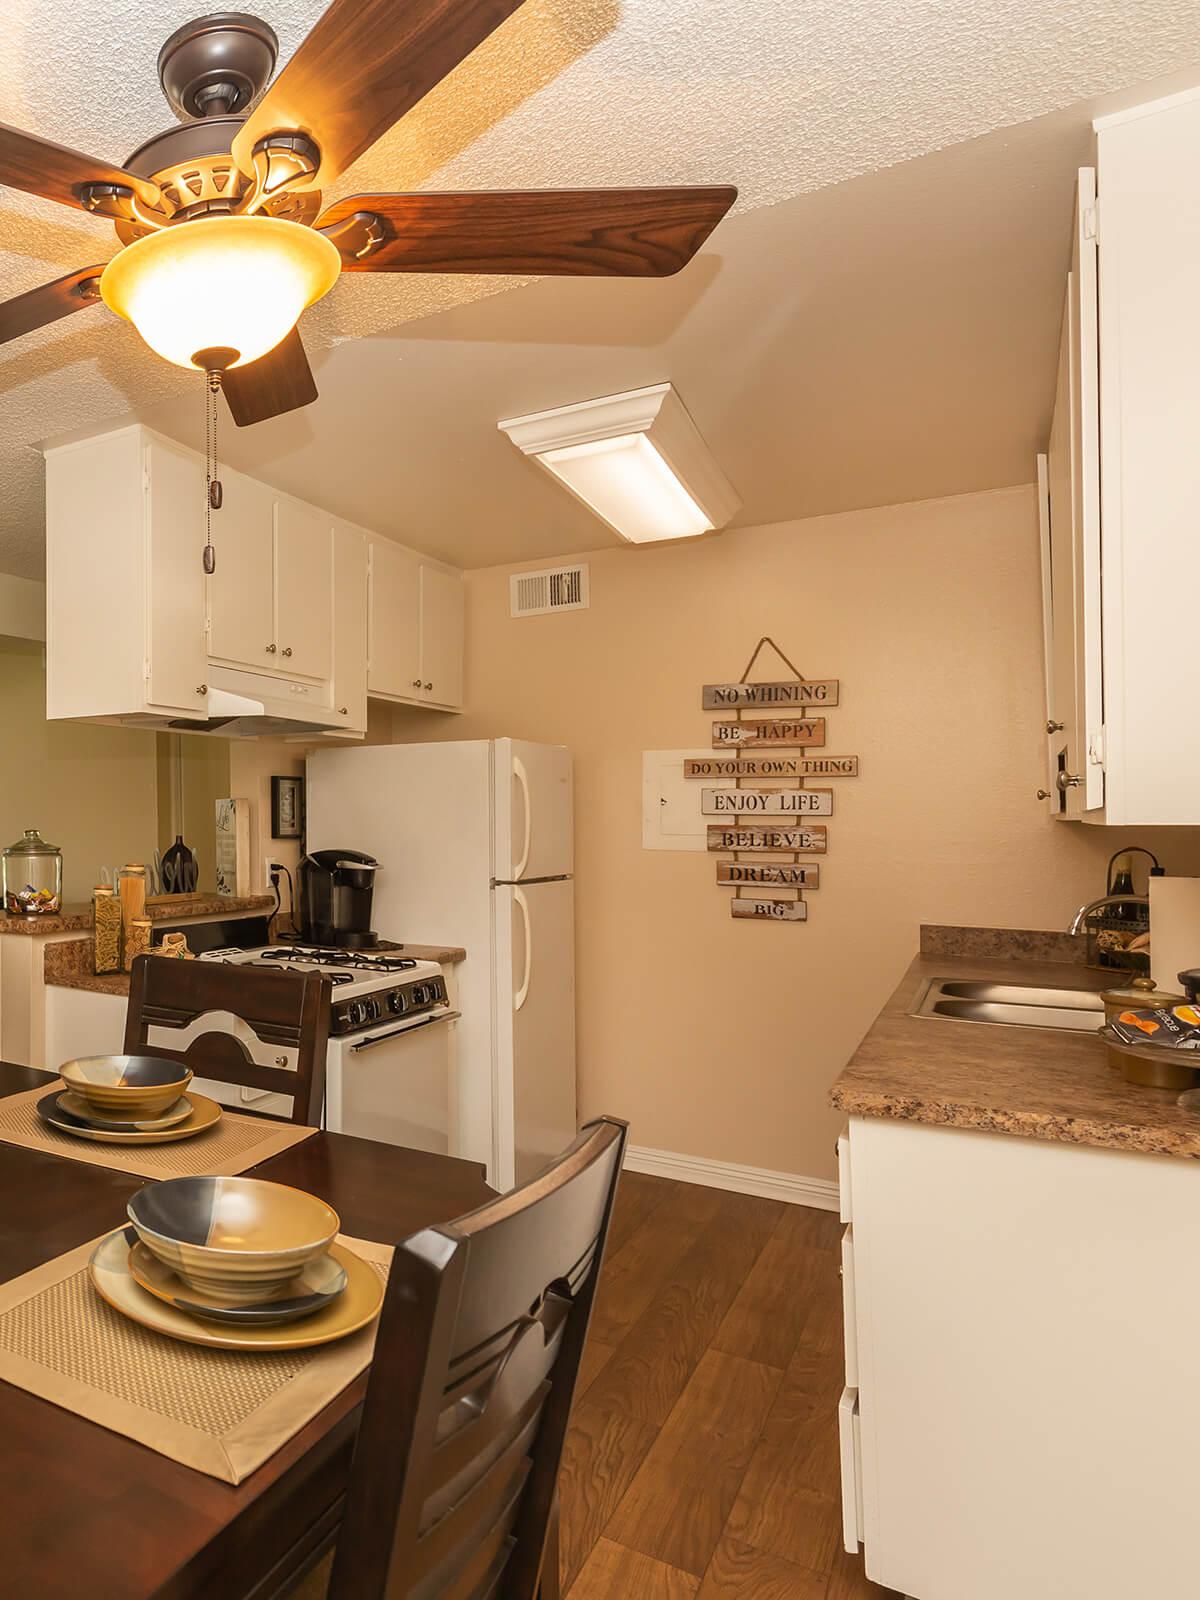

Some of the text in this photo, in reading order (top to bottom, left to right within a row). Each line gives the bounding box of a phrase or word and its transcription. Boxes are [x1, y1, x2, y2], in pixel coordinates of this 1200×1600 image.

[713, 685, 827, 704] NO WHINING
[718, 724, 816, 739] BE HAPPY
[691, 760, 853, 775] DO YOUR OWN THING
[714, 795, 820, 811] ENJOY LIFE
[729, 867, 807, 884] DREAM
[754, 904, 785, 916] BIG
